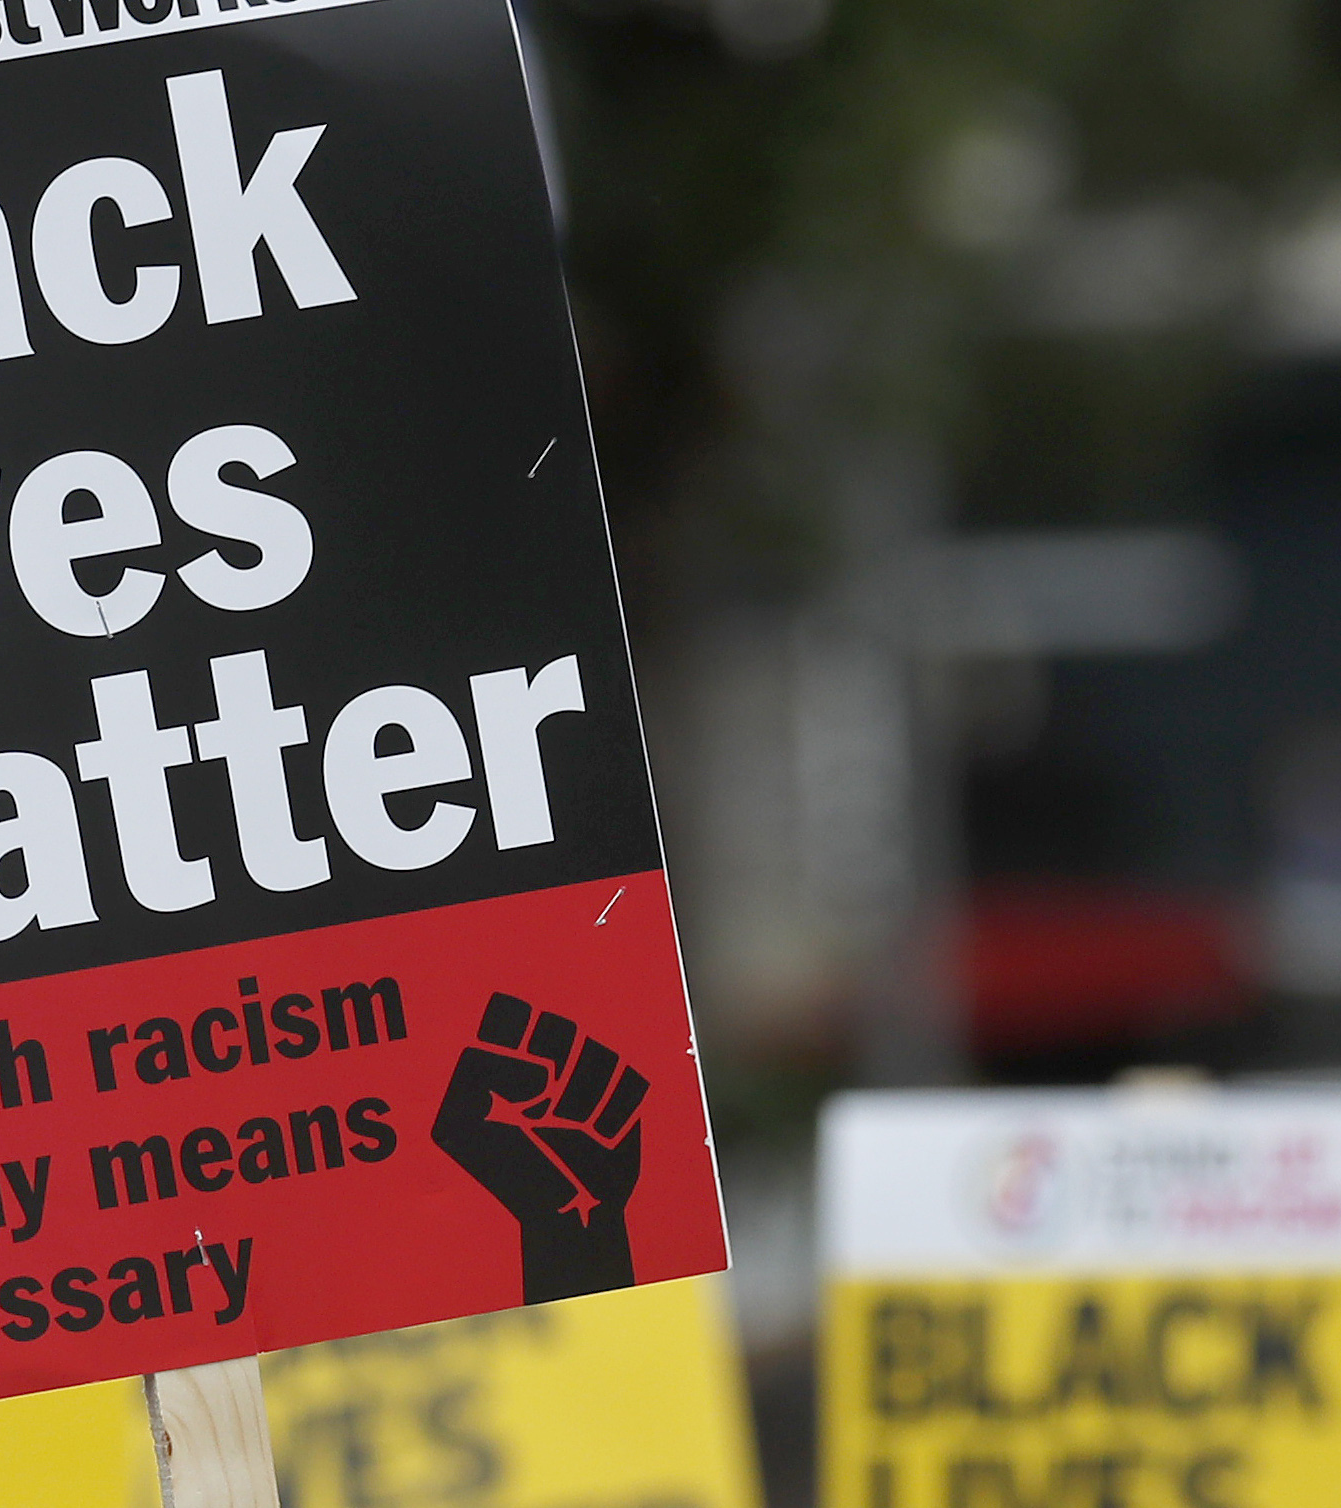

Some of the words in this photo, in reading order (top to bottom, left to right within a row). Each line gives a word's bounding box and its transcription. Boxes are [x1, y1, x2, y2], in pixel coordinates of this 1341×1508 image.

[86, 976, 409, 1093] racism
[89, 1095, 399, 1211] means
[865, 1288, 1338, 1428] BLACK
